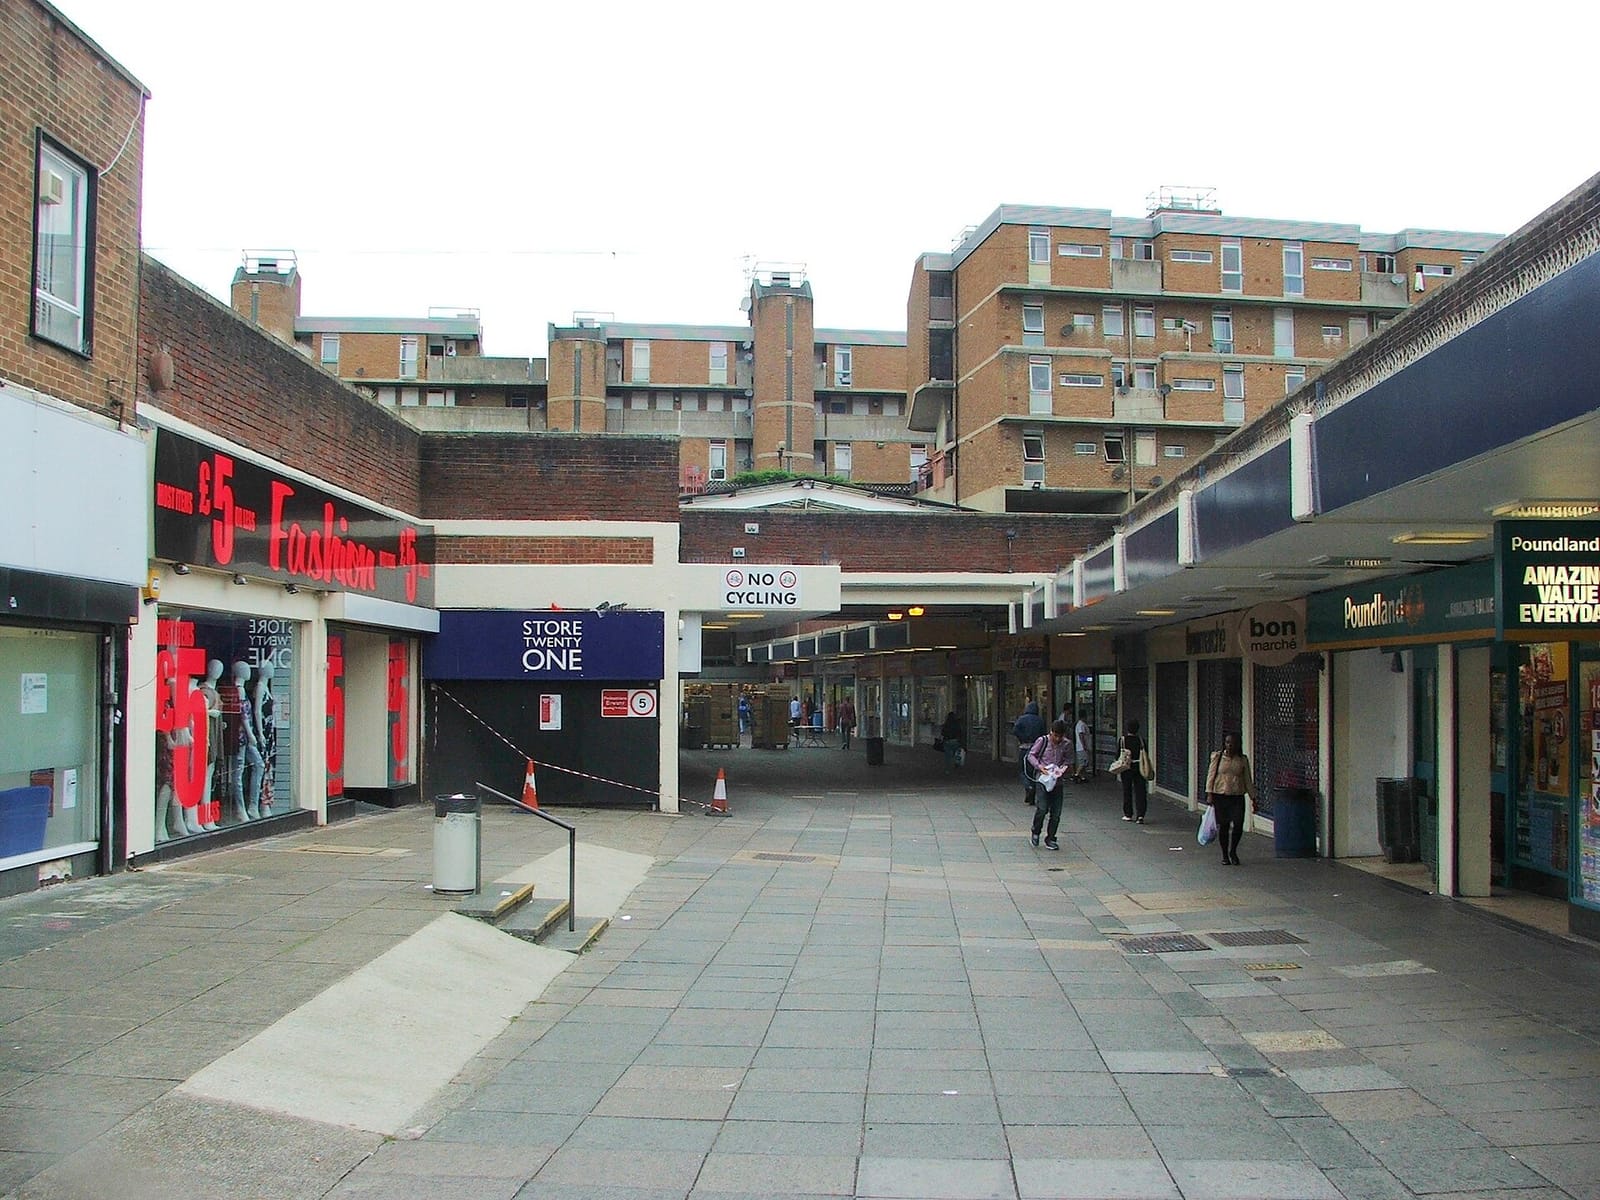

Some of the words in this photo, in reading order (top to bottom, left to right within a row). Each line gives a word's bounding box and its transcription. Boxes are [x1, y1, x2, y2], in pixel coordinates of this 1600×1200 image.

[199, 453, 234, 565] £5
[269, 480, 375, 591] Fashion
[1511, 536, 1600, 552] Poundland
[748, 573, 774, 586] NO
[726, 591, 797, 605] CYCLING
[1537, 585, 1599, 604] VALUE
[1345, 590, 1404, 629] Poundland
[523, 621, 583, 636] STORE
[1250, 617, 1296, 637] bon
[523, 637, 582, 648] TWENTY
[1251, 638, 1297, 652] marché
[522, 649, 583, 671] ONE
[639, 698, 647, 708] 5
